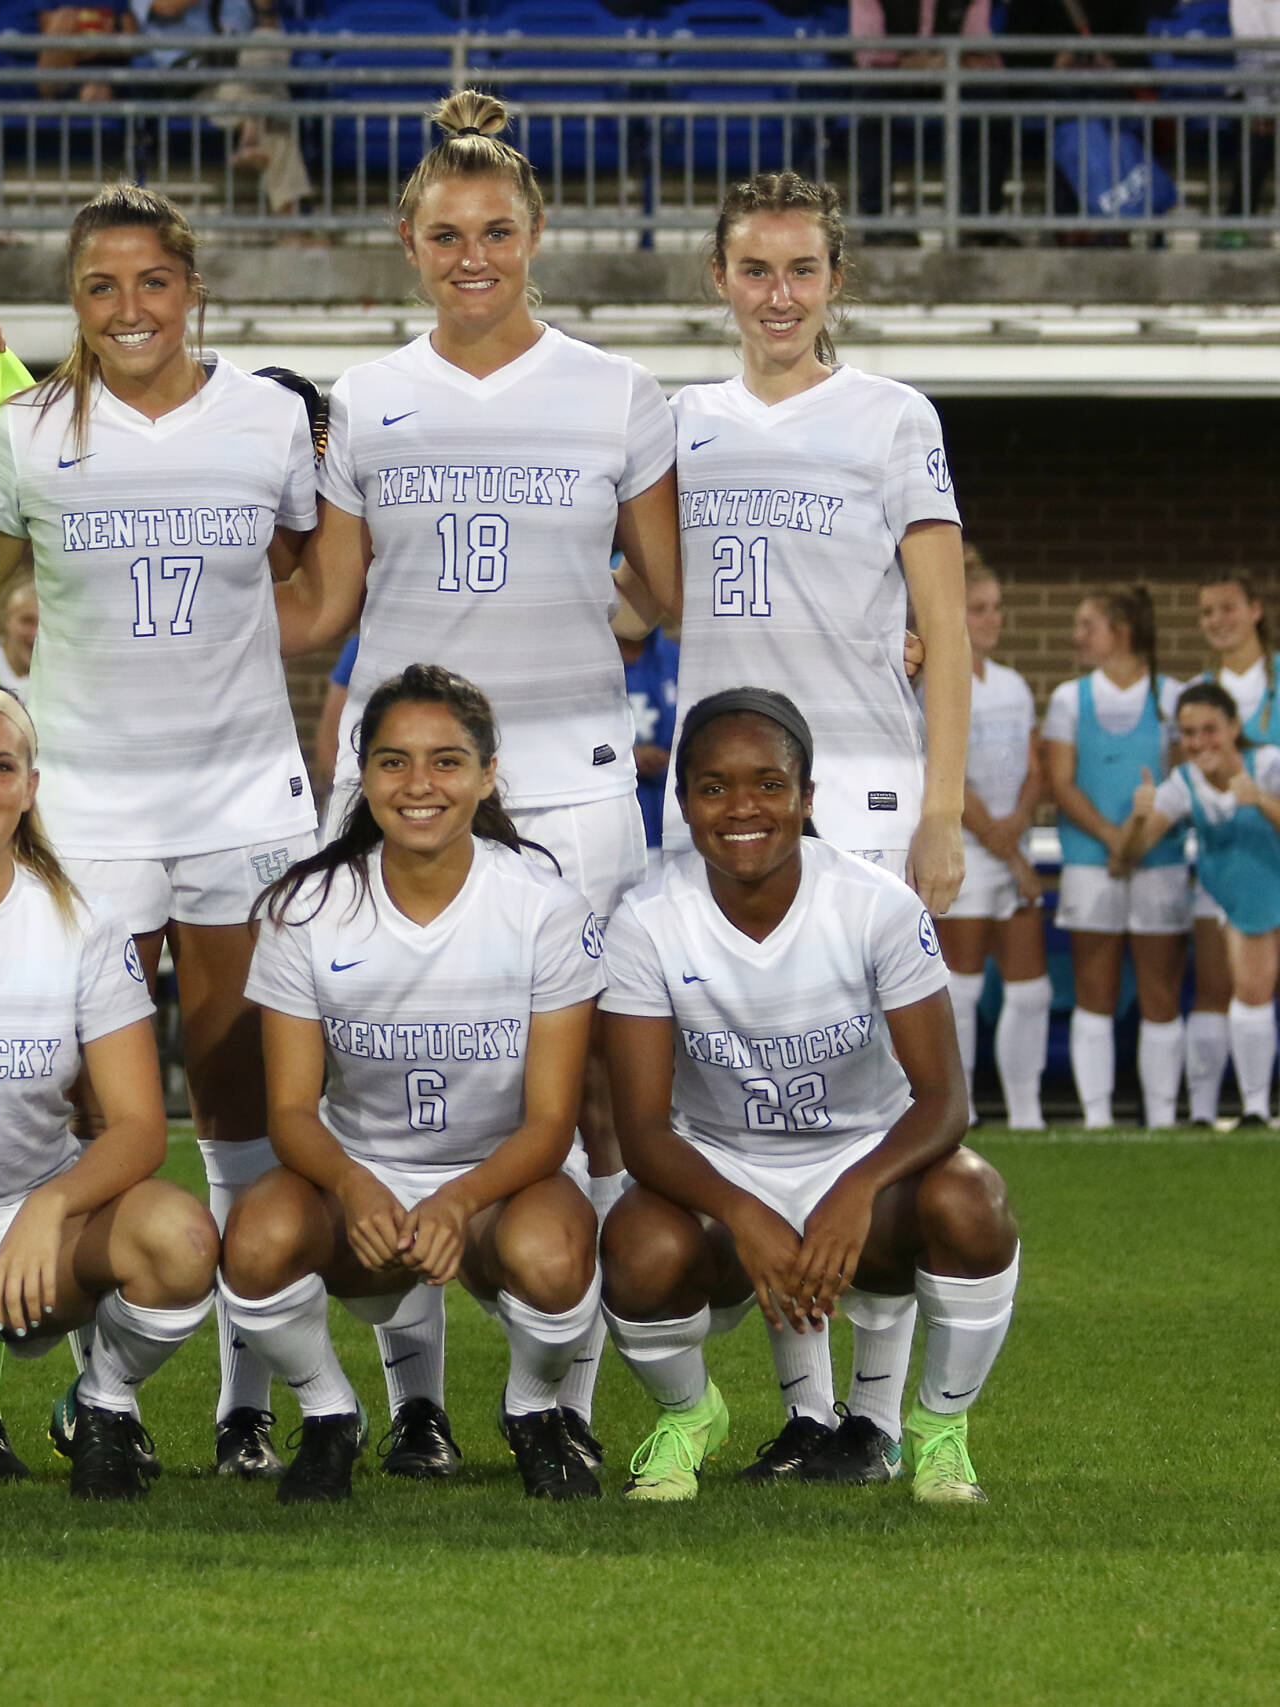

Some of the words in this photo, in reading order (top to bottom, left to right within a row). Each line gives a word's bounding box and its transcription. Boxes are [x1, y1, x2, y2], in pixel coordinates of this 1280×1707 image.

[378, 465, 580, 506] KENTUCKY
[680, 489, 843, 536] KENTUCKY
[63, 507, 258, 553] KENTUCKY
[436, 513, 509, 593] 18
[130, 555, 204, 637] 17
[712, 535, 772, 617] 21
[323, 1017, 521, 1061] KENTUCKY
[681, 1014, 874, 1071] KENTUCKY
[405, 1068, 448, 1132] 6
[742, 1071, 833, 1131] 22
